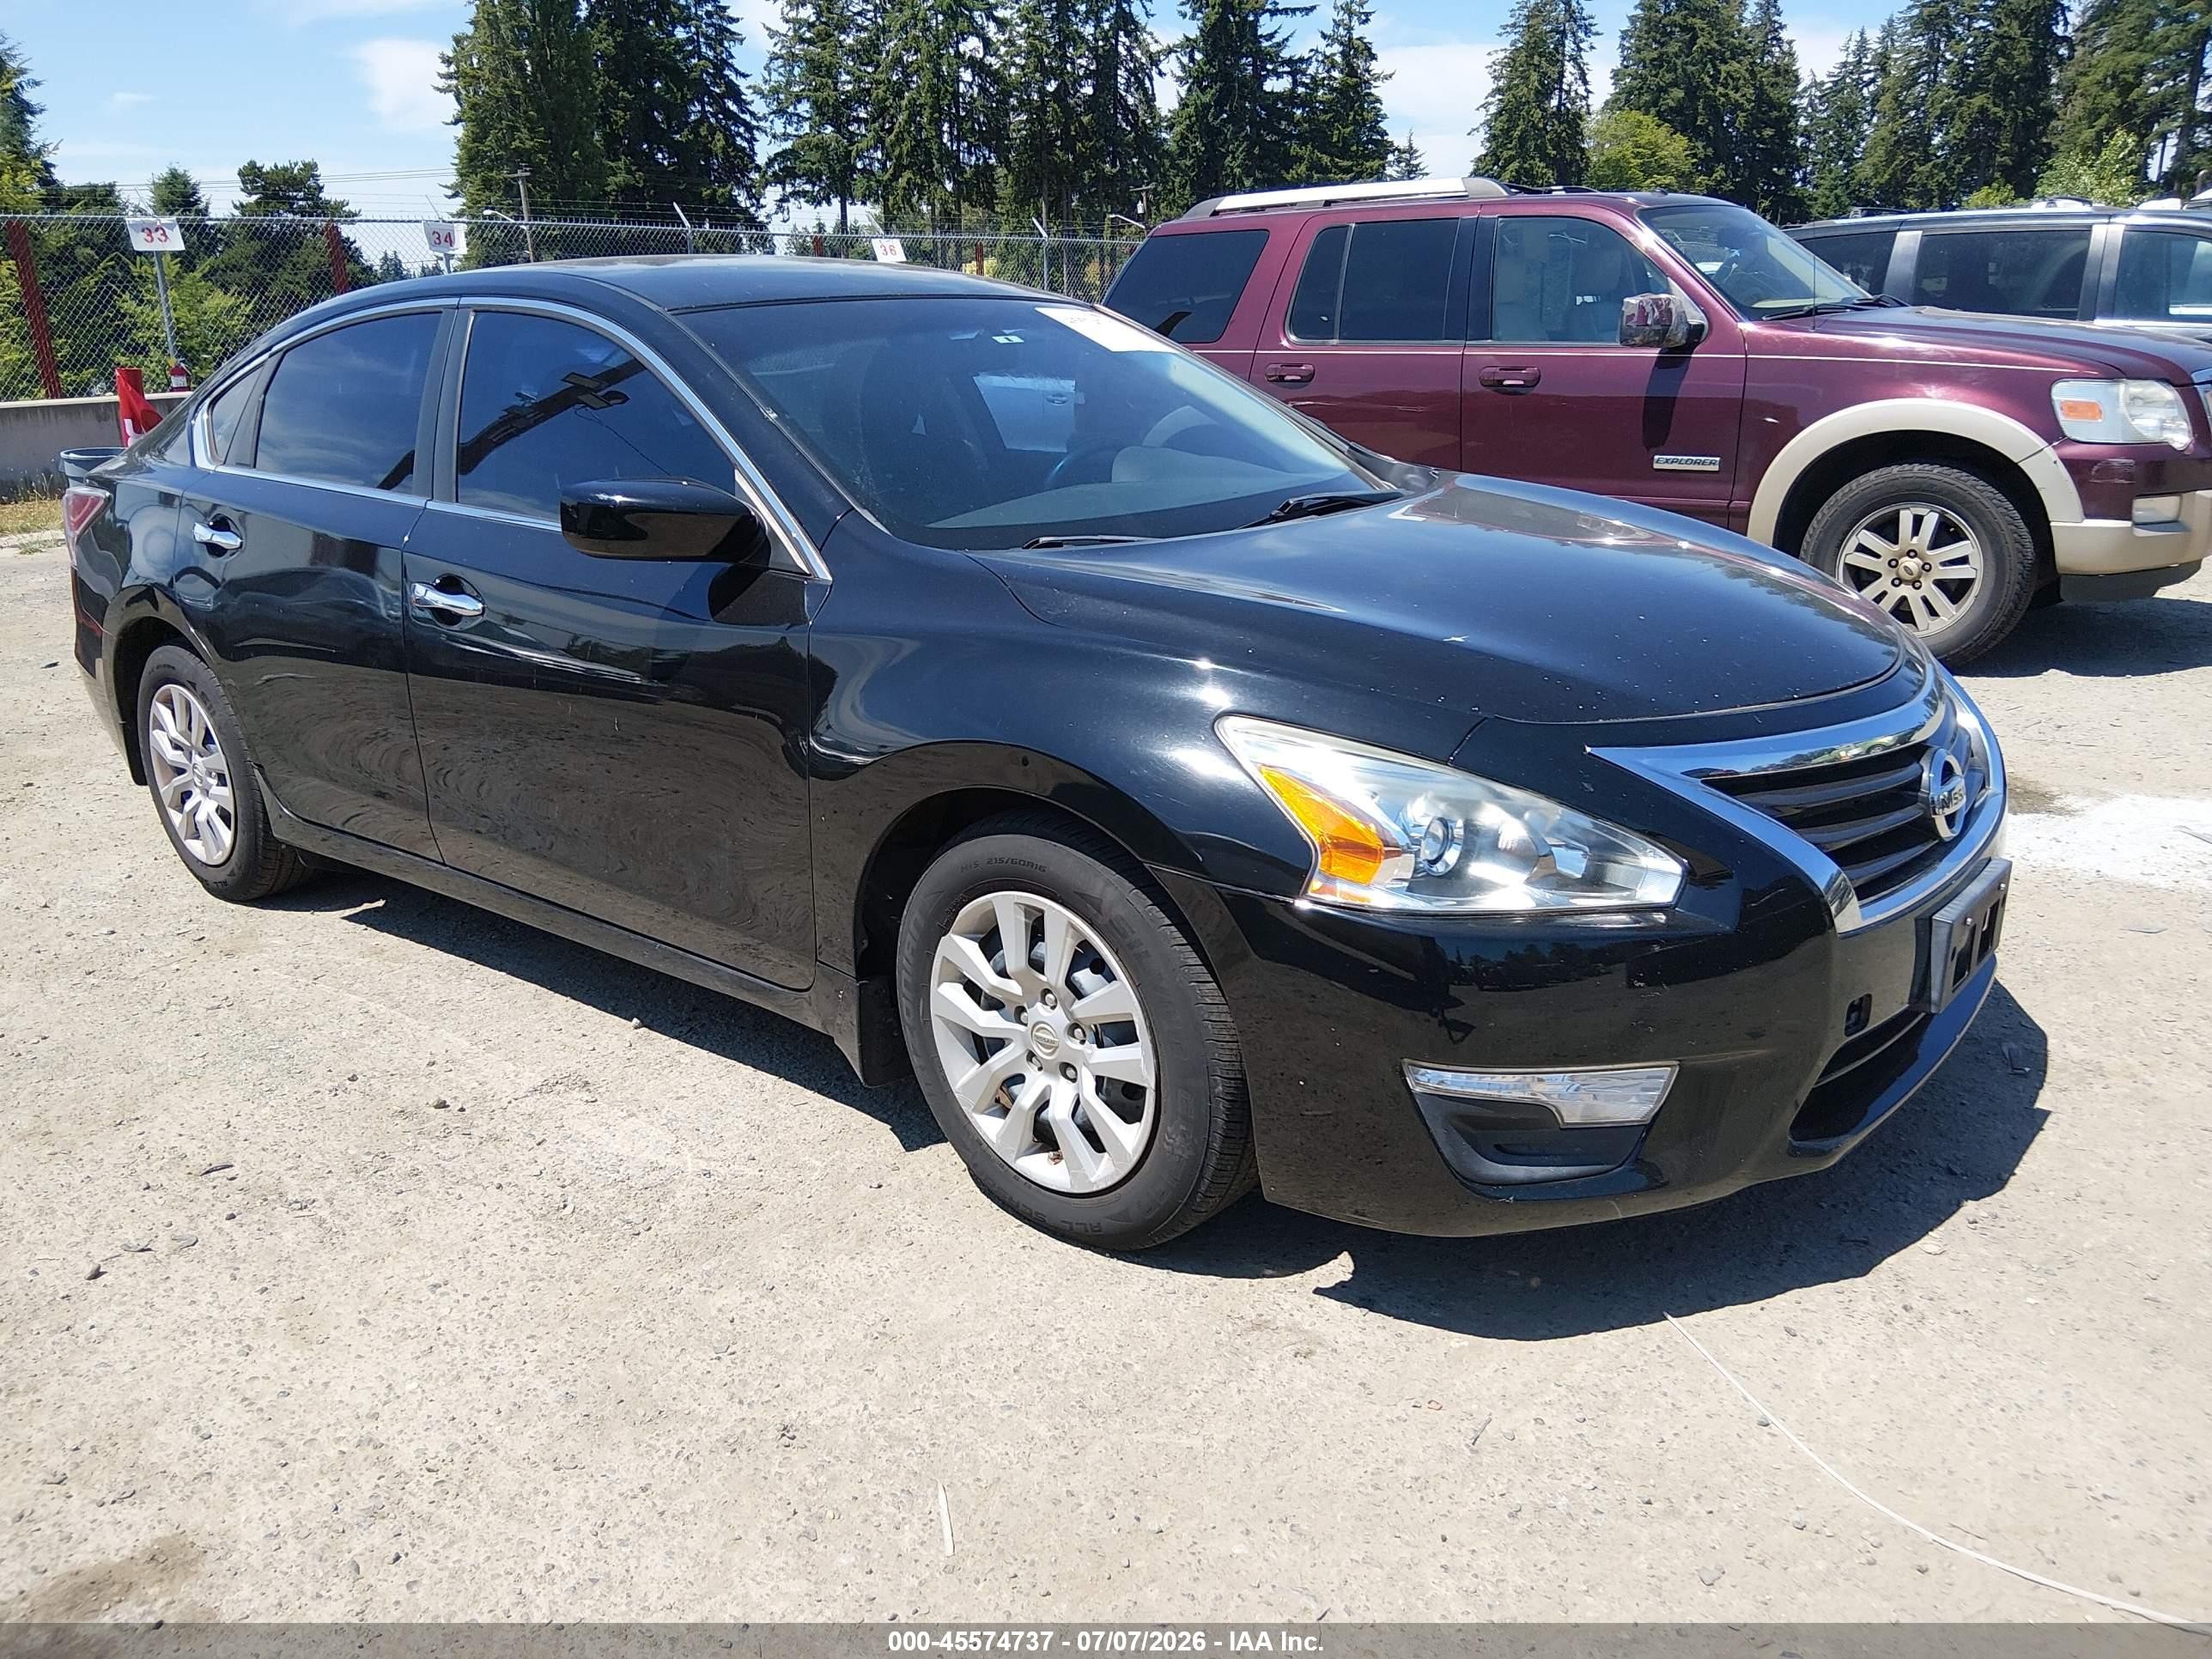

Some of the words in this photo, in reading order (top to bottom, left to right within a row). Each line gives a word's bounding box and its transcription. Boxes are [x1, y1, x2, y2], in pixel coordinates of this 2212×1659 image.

[142, 227, 167, 243] 33
[432, 230, 453, 247] 34
[879, 244, 896, 256] 36
[1656, 457, 1718, 466] EXPLORER
[987, 858, 1048, 872] 215/60R16
